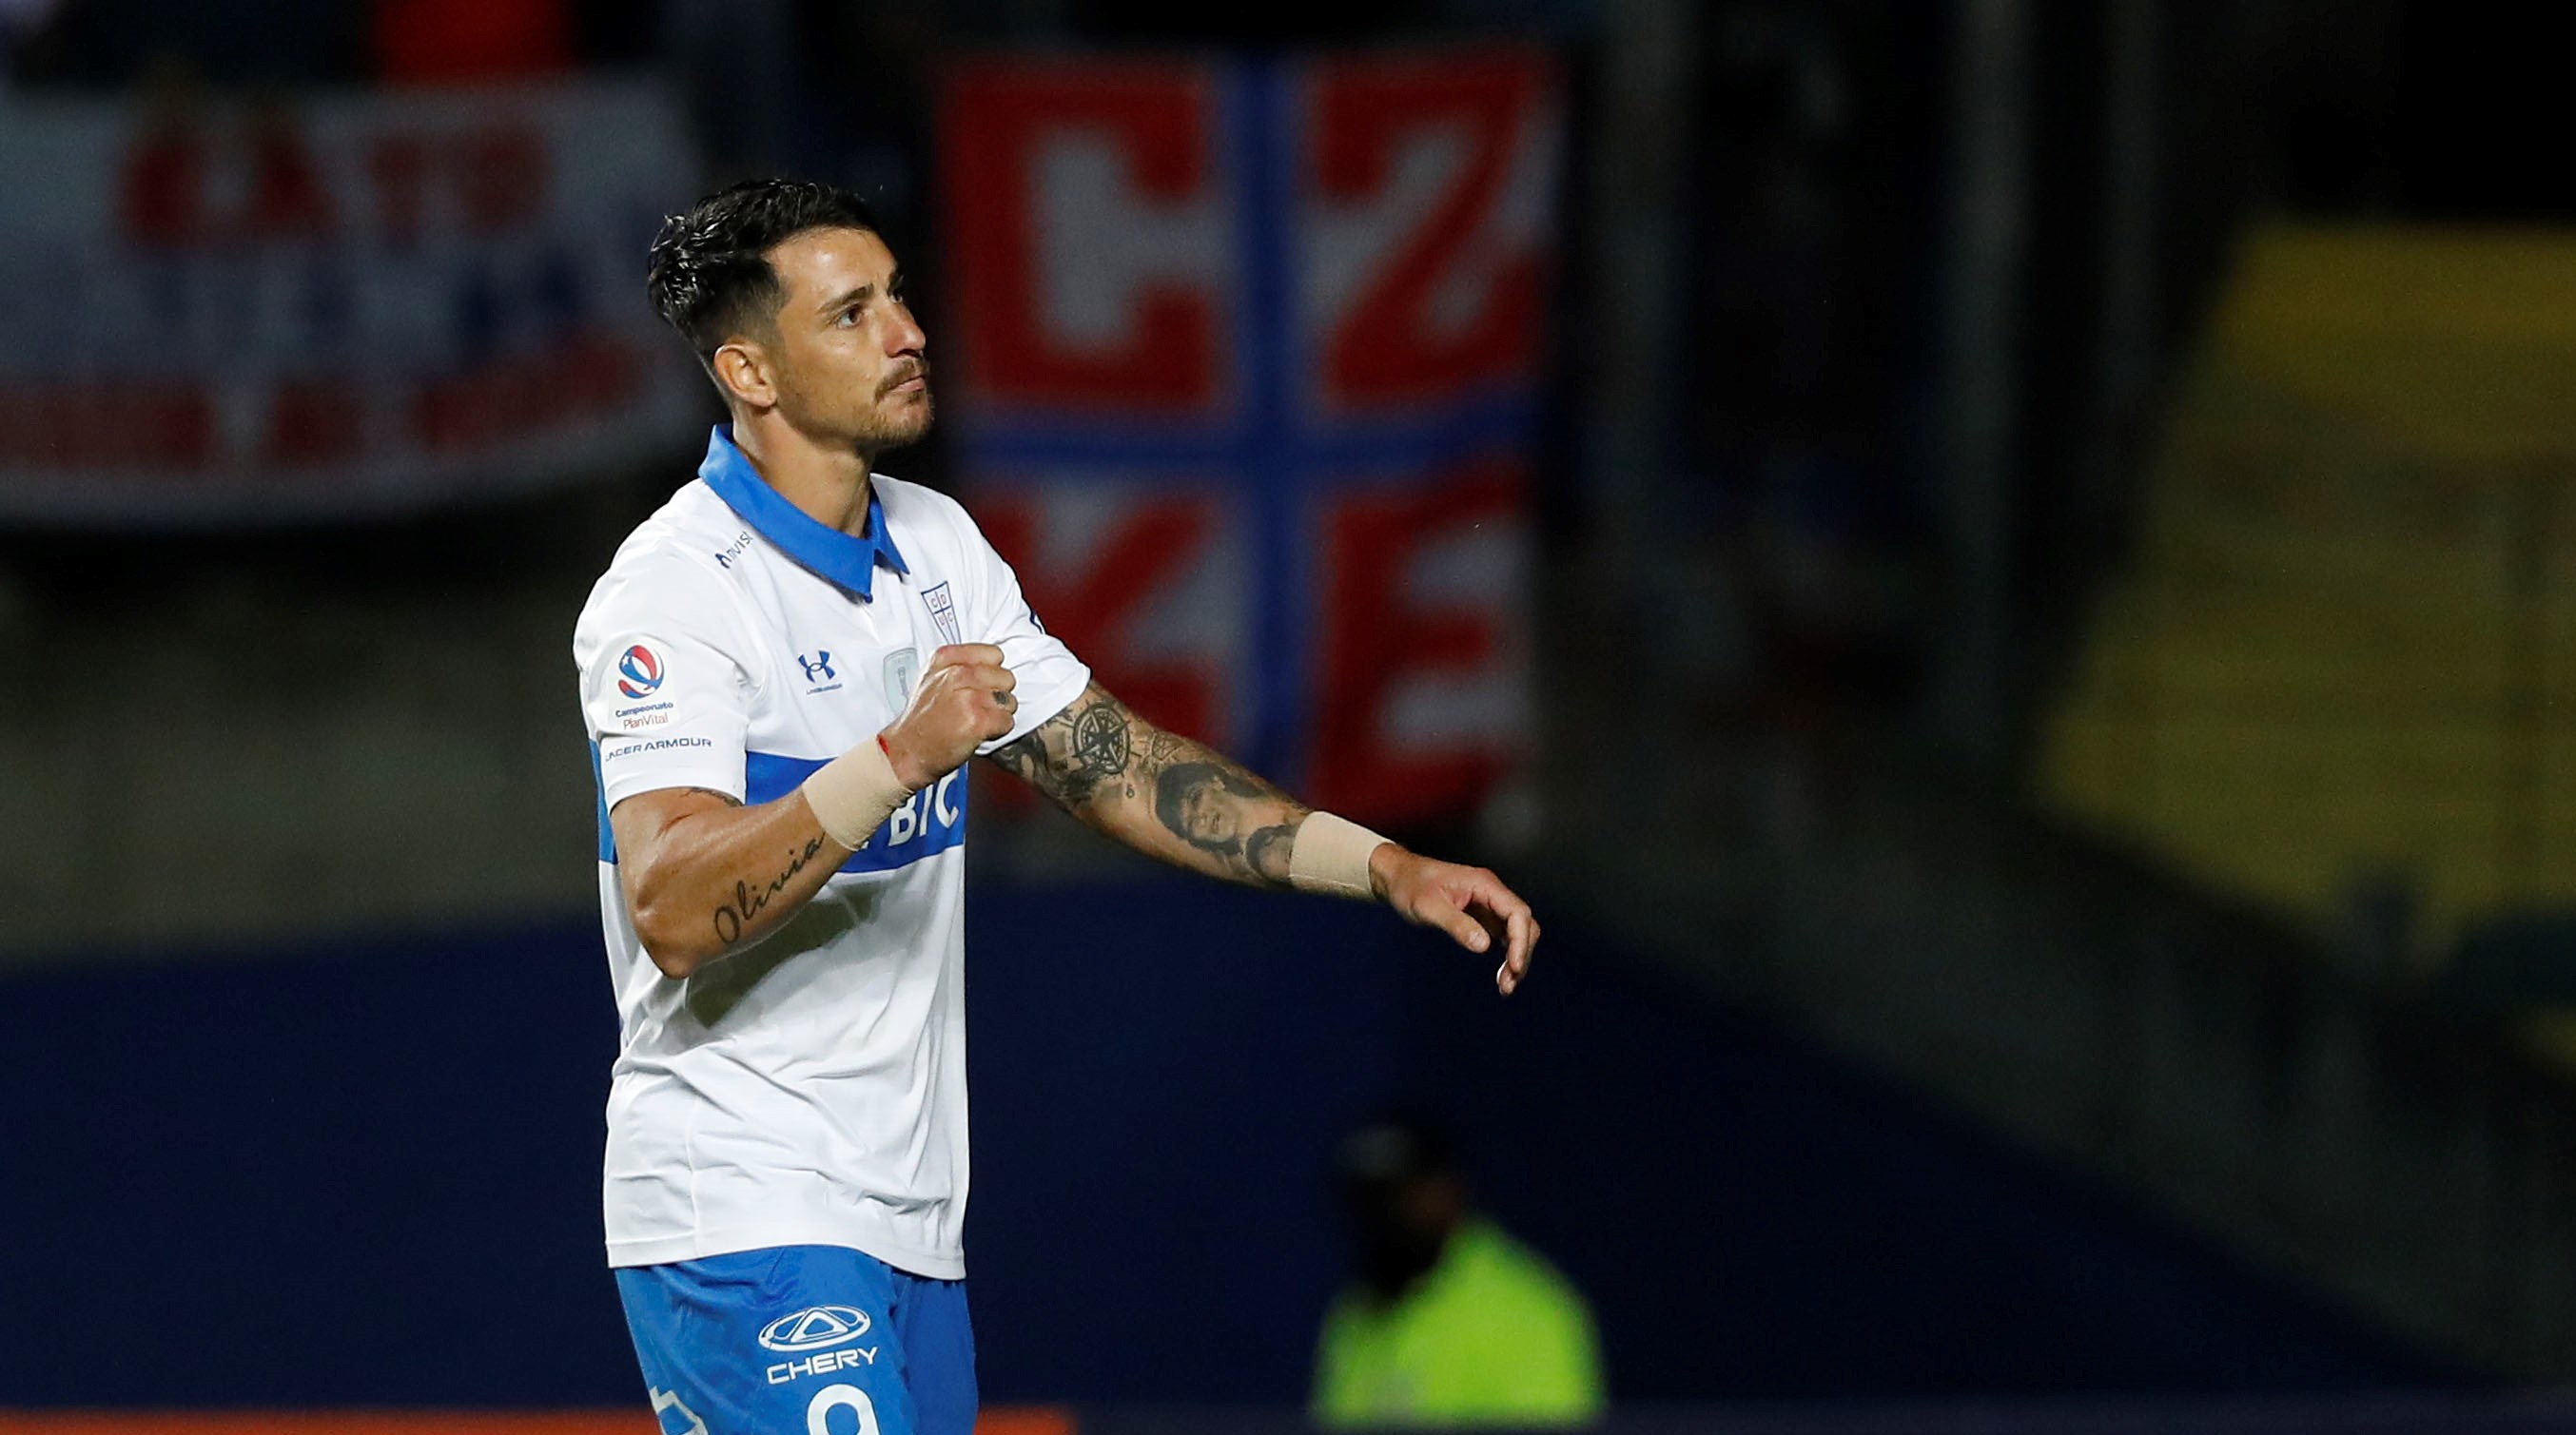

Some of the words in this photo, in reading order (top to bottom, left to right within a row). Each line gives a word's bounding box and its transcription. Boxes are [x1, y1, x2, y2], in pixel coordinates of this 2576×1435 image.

[615, 702, 674, 718] Campeonato
[644, 737, 712, 751] ARMOUR
[713, 830, 826, 944] Olivia
[766, 1346, 879, 1386] CHERY
